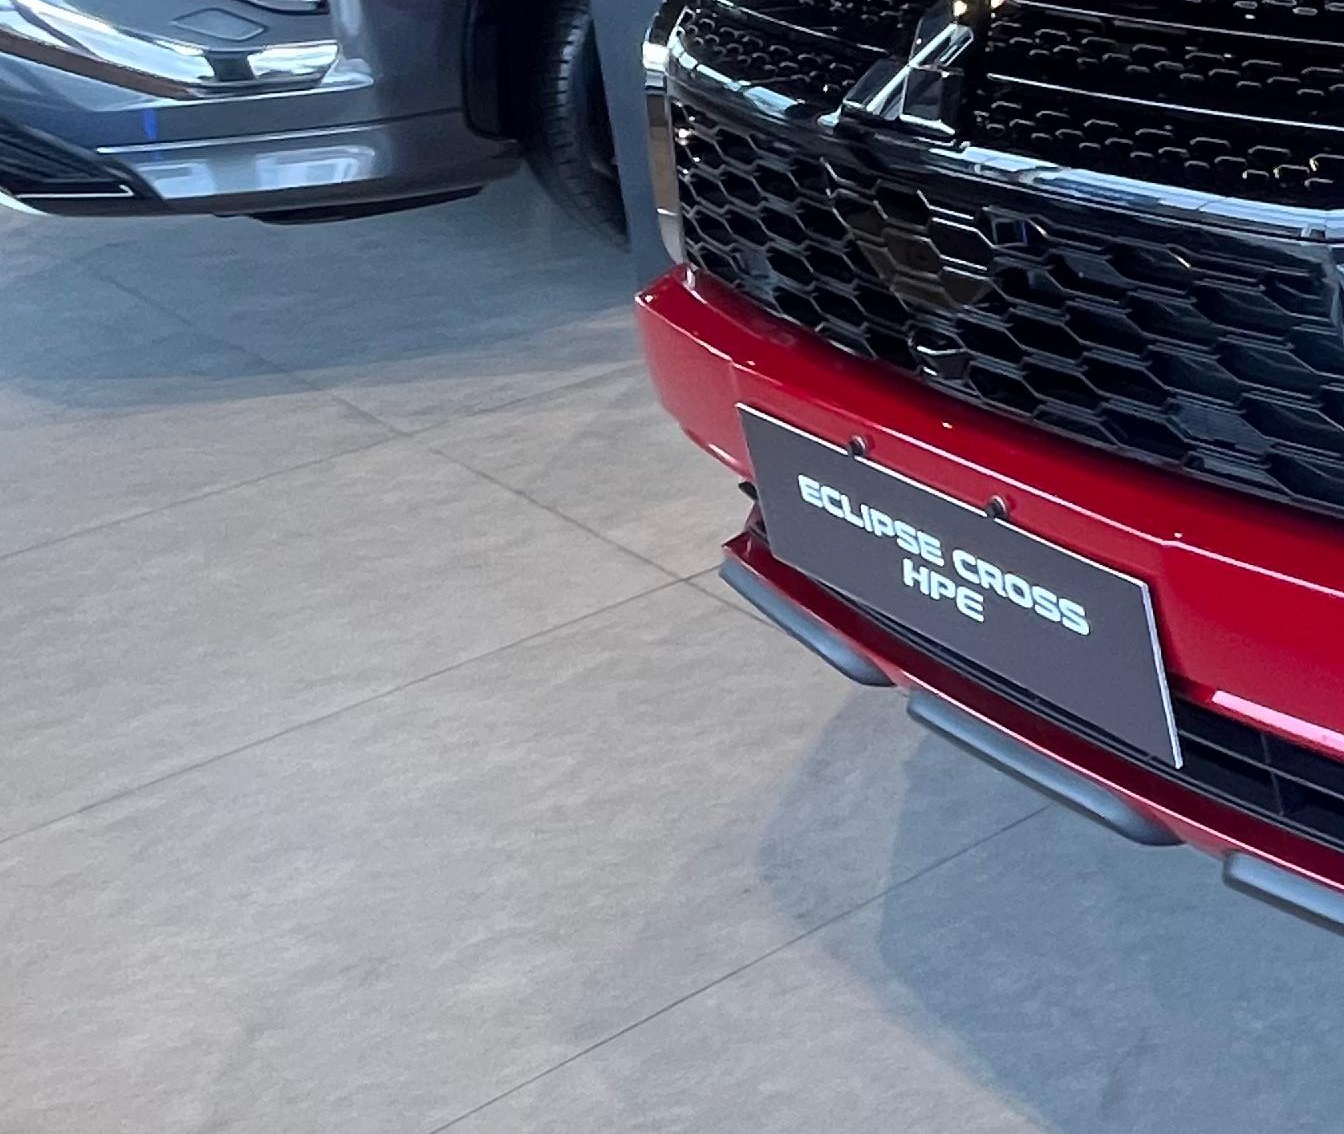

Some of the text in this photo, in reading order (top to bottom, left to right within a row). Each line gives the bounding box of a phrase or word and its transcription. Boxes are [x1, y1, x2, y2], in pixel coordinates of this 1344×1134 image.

[798, 474, 1090, 636] ECLIPSE CROSS
[902, 558, 986, 623] HPE
